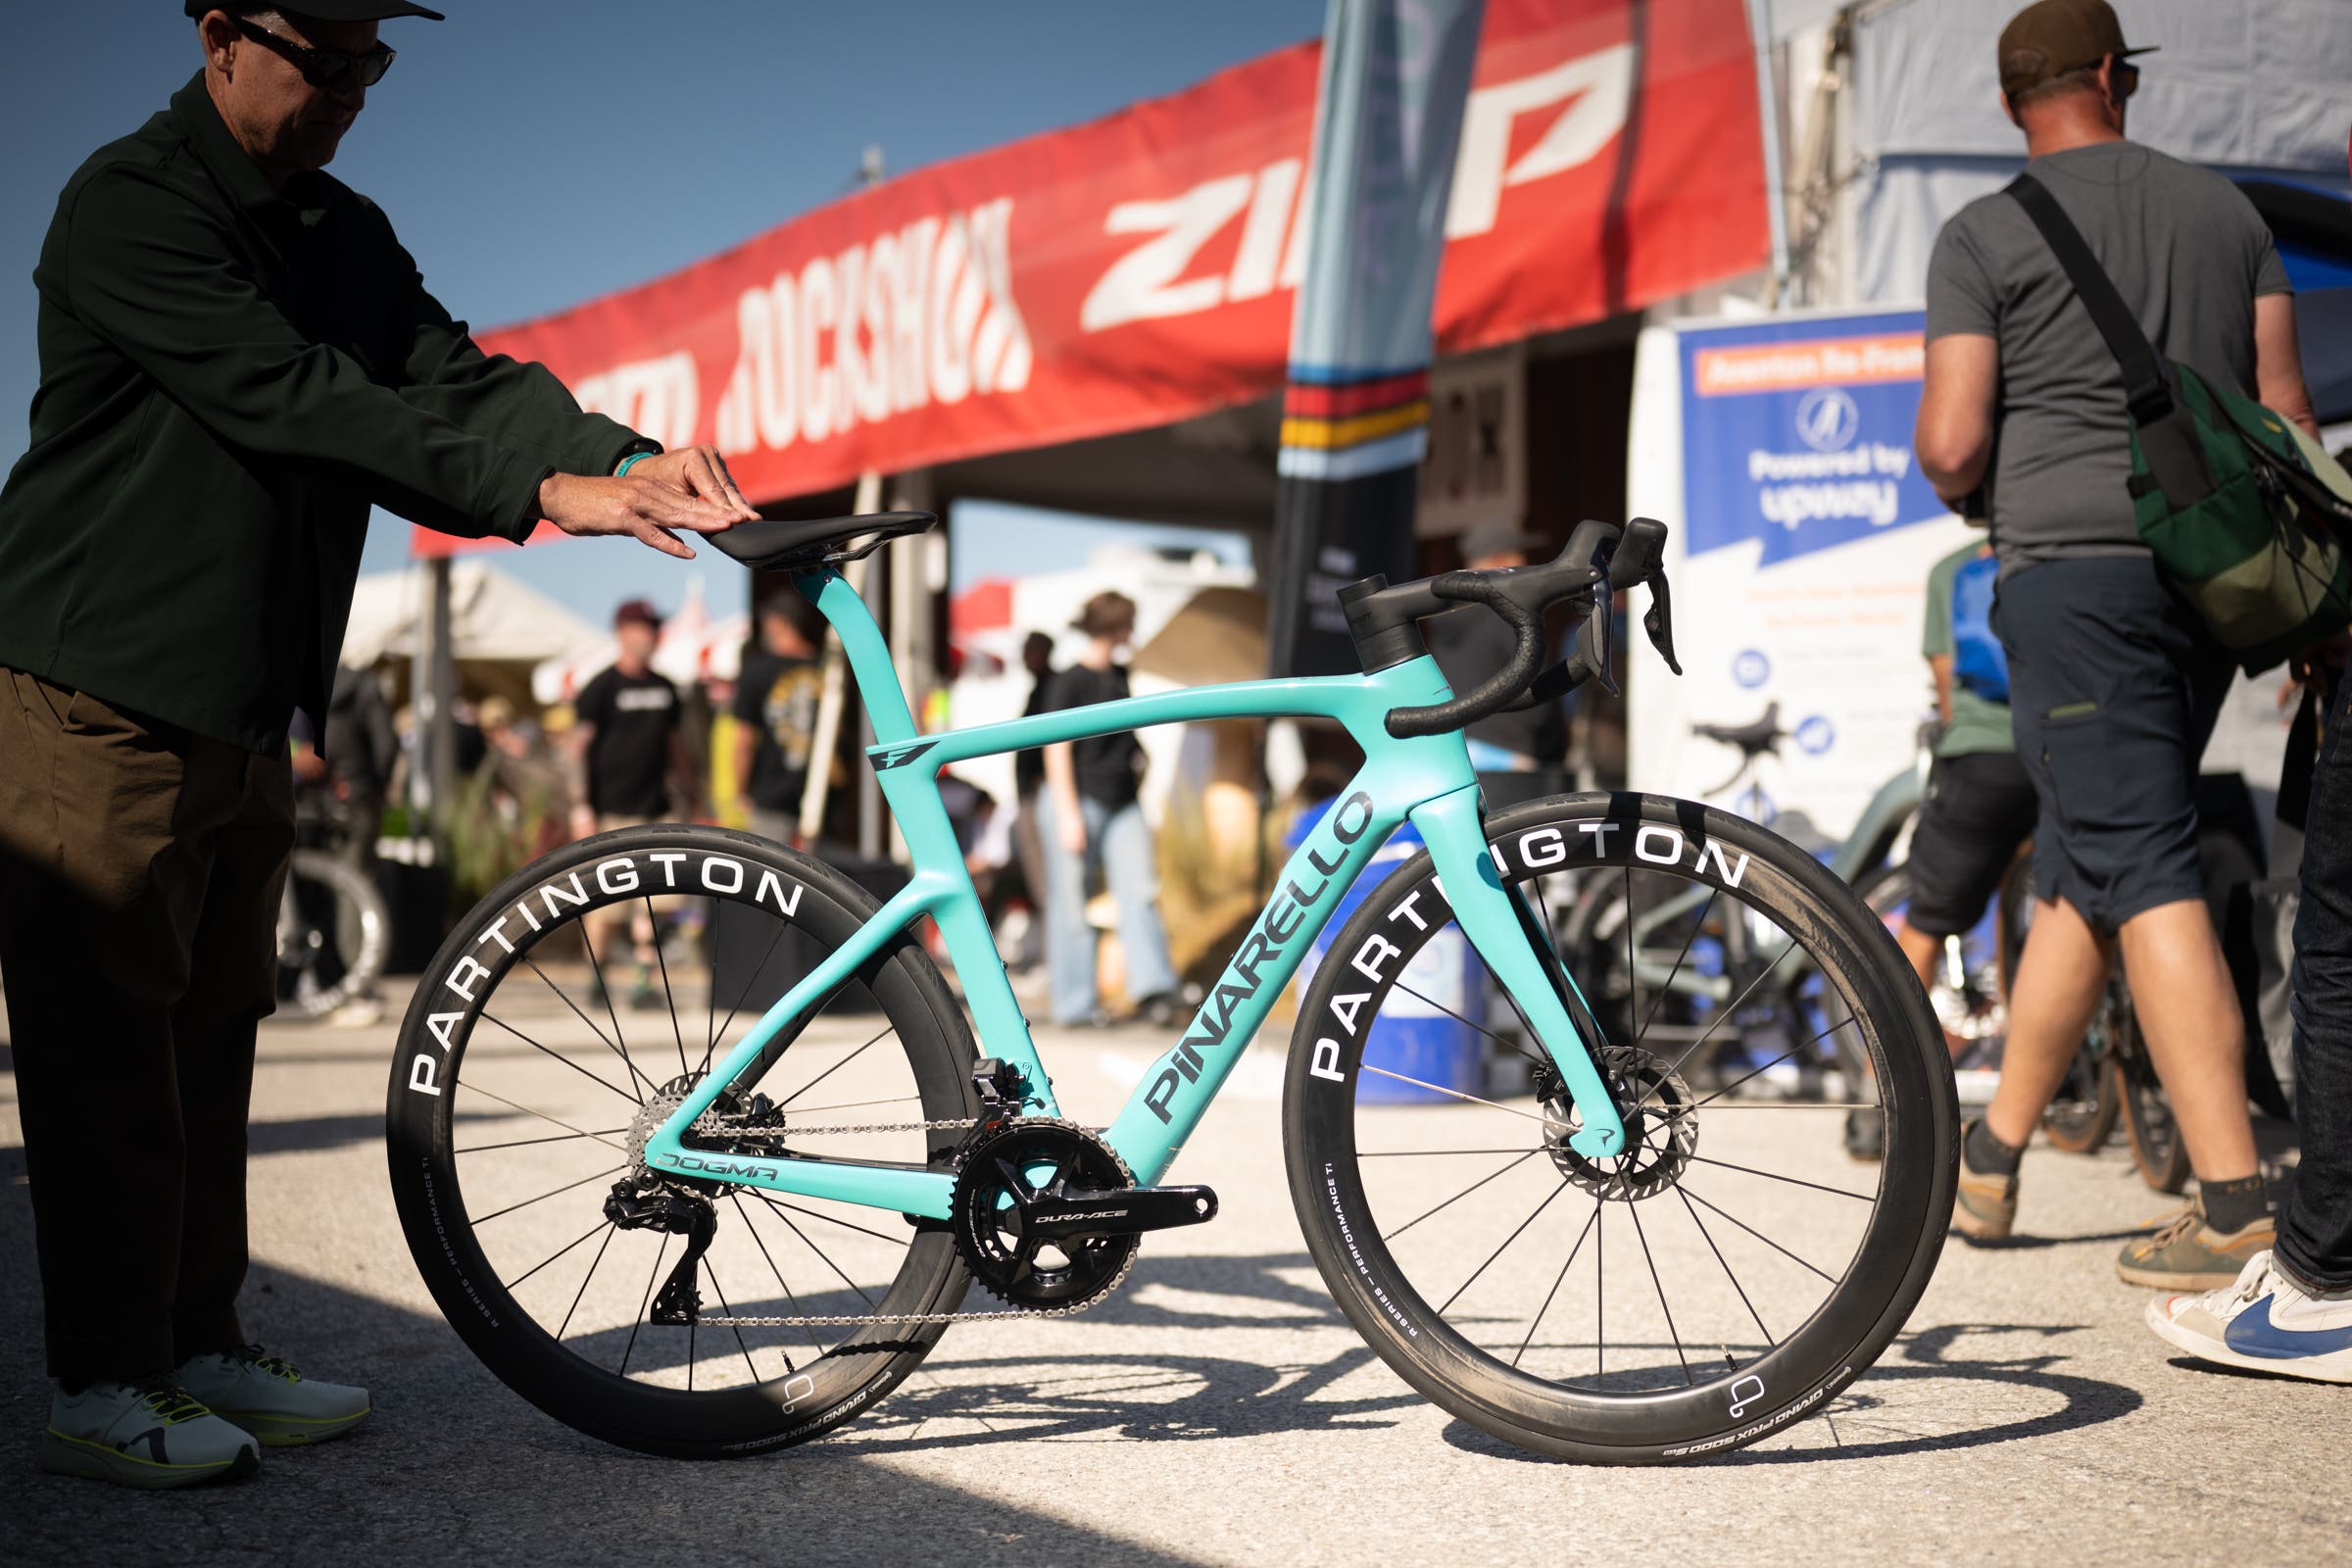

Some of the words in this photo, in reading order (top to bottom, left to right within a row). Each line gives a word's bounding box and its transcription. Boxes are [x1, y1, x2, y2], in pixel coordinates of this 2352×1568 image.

[1081, 43, 1635, 331] ZIP
[715, 197, 1033, 456] ROCKSHOX
[1748, 444, 1871, 481] Powered
[1873, 442, 1910, 479] by
[1760, 481, 1898, 530] upway
[409, 853, 804, 1097] PARTINGTON
[1143, 790, 1374, 1126] PINARELLO
[655, 1152, 778, 1181] DOGMA
[423, 1172, 458, 1265] PERFORMANCE
[1035, 1209, 1129, 1224] DURA-ACE
[1327, 1178, 1369, 1275] PERFORMANCE
[822, 1391, 867, 1425] GRAND
[1776, 1388, 1824, 1424] GRAND
[788, 1419, 822, 1439] PRIX
[1690, 1437, 1737, 1453] 5000
[1737, 1420, 1775, 1441] PRIX
